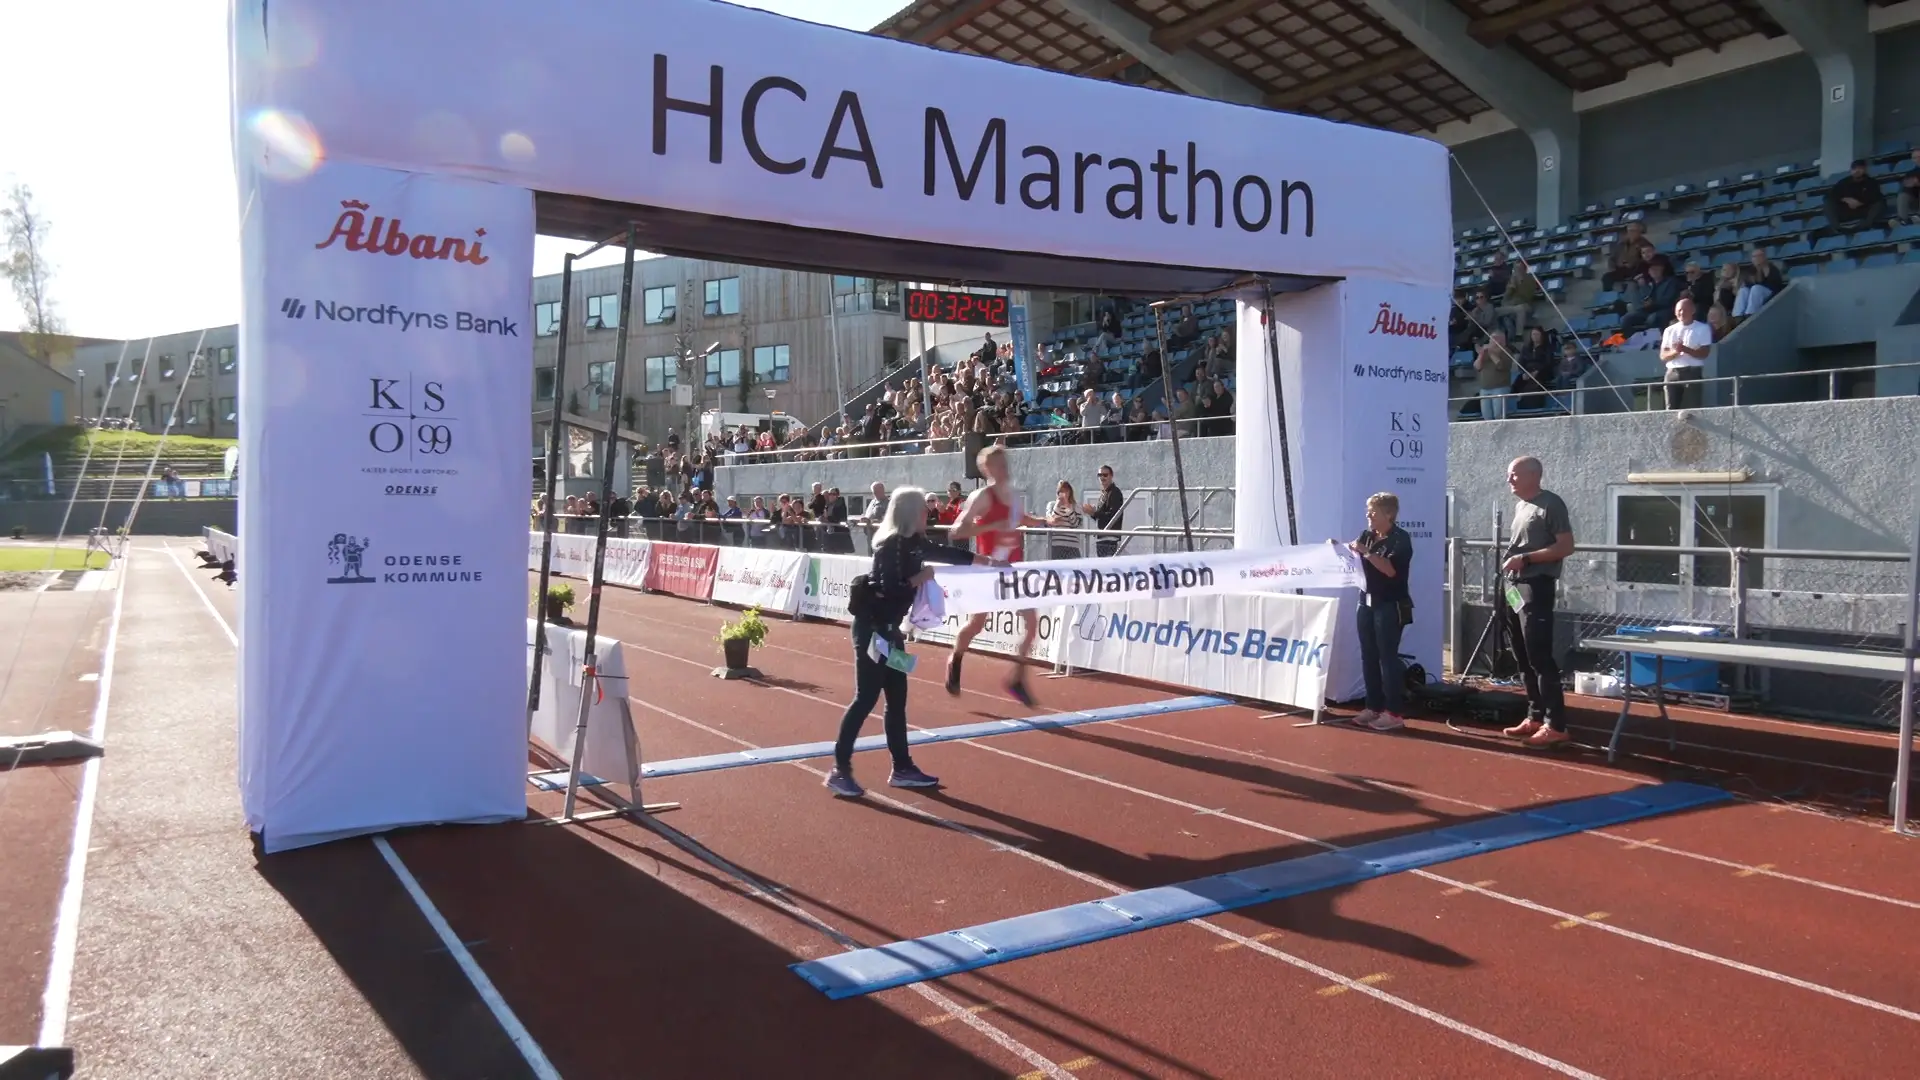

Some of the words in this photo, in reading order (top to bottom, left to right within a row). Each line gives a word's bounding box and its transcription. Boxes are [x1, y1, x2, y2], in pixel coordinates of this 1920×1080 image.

[1831, 87, 1842, 101] C
[652, 53, 884, 189] HCA
[923, 106, 1314, 238] Marathon
[315, 208, 491, 266] Albani
[315, 299, 449, 333] Nordfyns
[456, 312, 518, 337] Bank
[908, 291, 1005, 325] 00:32:42
[1369, 307, 1438, 340] Albani
[1368, 365, 1423, 383] Nordfyns
[1424, 369, 1447, 384] Bank
[369, 378, 403, 411] K
[423, 381, 445, 413] S
[369, 422, 403, 454] O
[417, 424, 452, 455] 99
[1390, 412, 1404, 432] K
[1412, 412, 1421, 432] S
[1409, 440, 1423, 459] 99
[384, 485, 438, 494] ODENSE
[384, 555, 462, 567] ODENSE
[384, 571, 483, 584] KOMMUNE
[821, 577, 850, 598] Odens
[999, 569, 1063, 600] HCA
[1073, 563, 1214, 595] Marathon
[1107, 612, 1238, 655] Nordfyns
[1241, 629, 1328, 668] Bank
